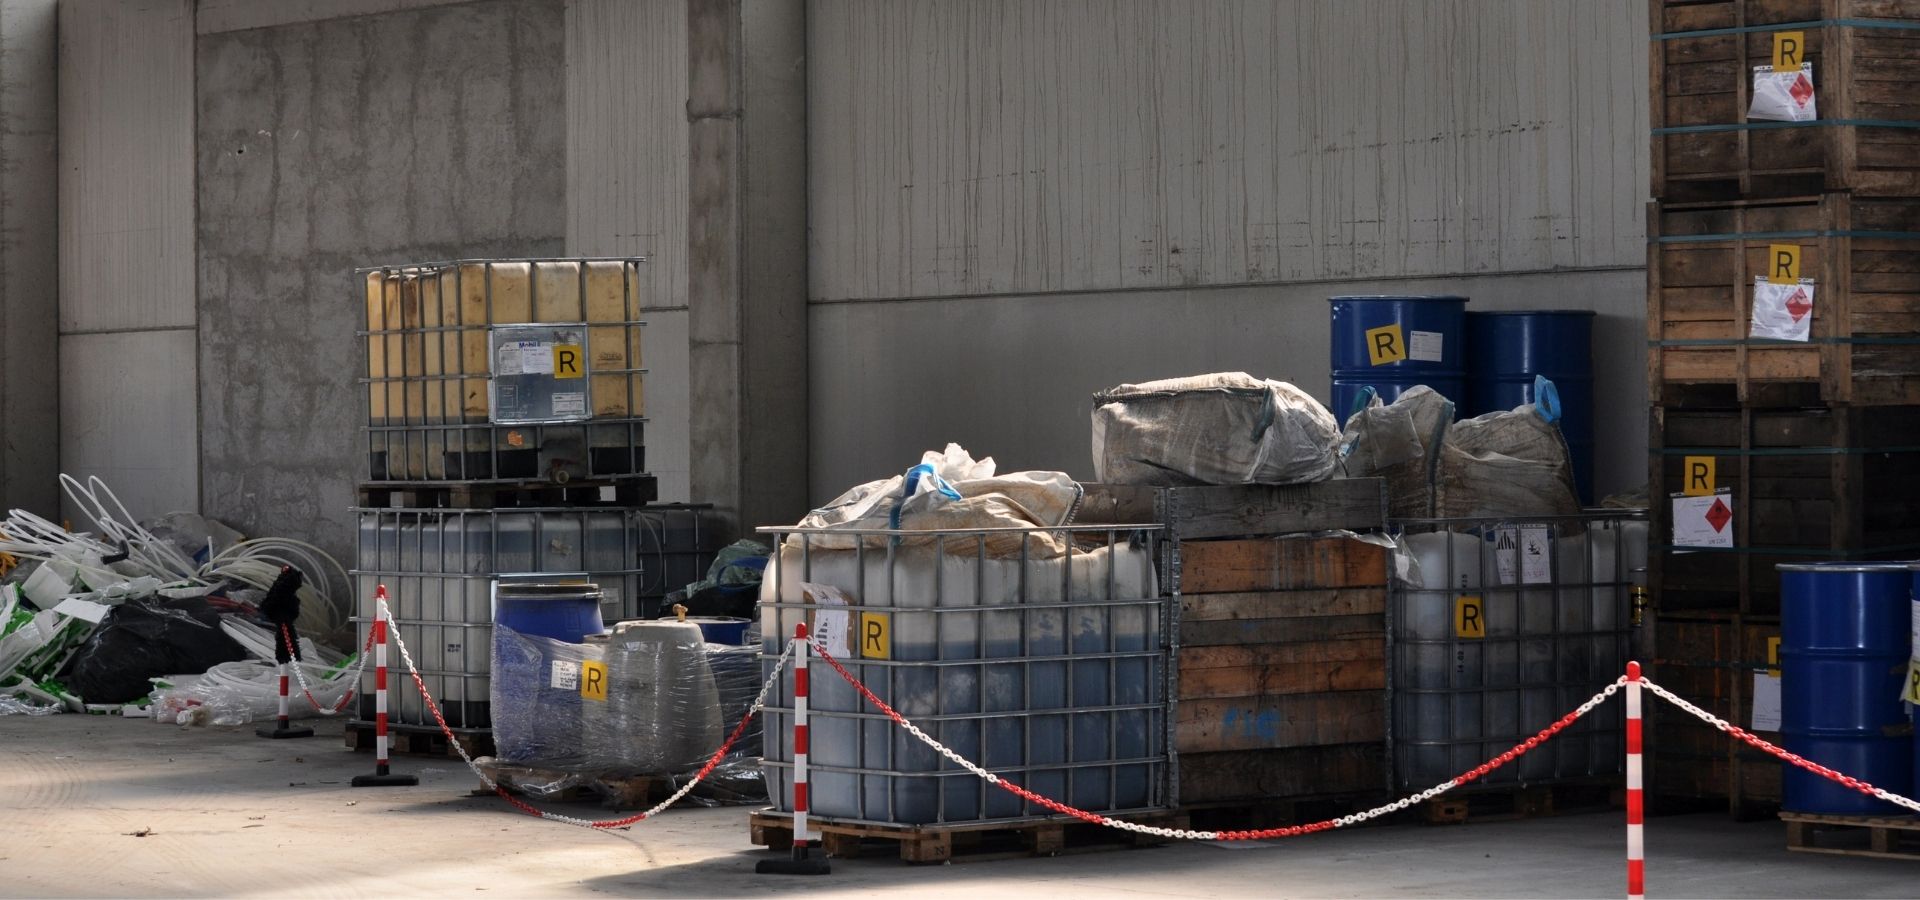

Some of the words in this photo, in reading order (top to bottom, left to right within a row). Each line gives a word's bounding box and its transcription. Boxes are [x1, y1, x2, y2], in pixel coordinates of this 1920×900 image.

[1781, 39, 1796, 66] R
[1776, 251, 1793, 278] R
[1375, 333, 1397, 358] R
[560, 351, 576, 373] R
[1693, 463, 1708, 490] R
[1463, 604, 1479, 631] R
[867, 621, 882, 651] R
[587, 667, 601, 694] R
